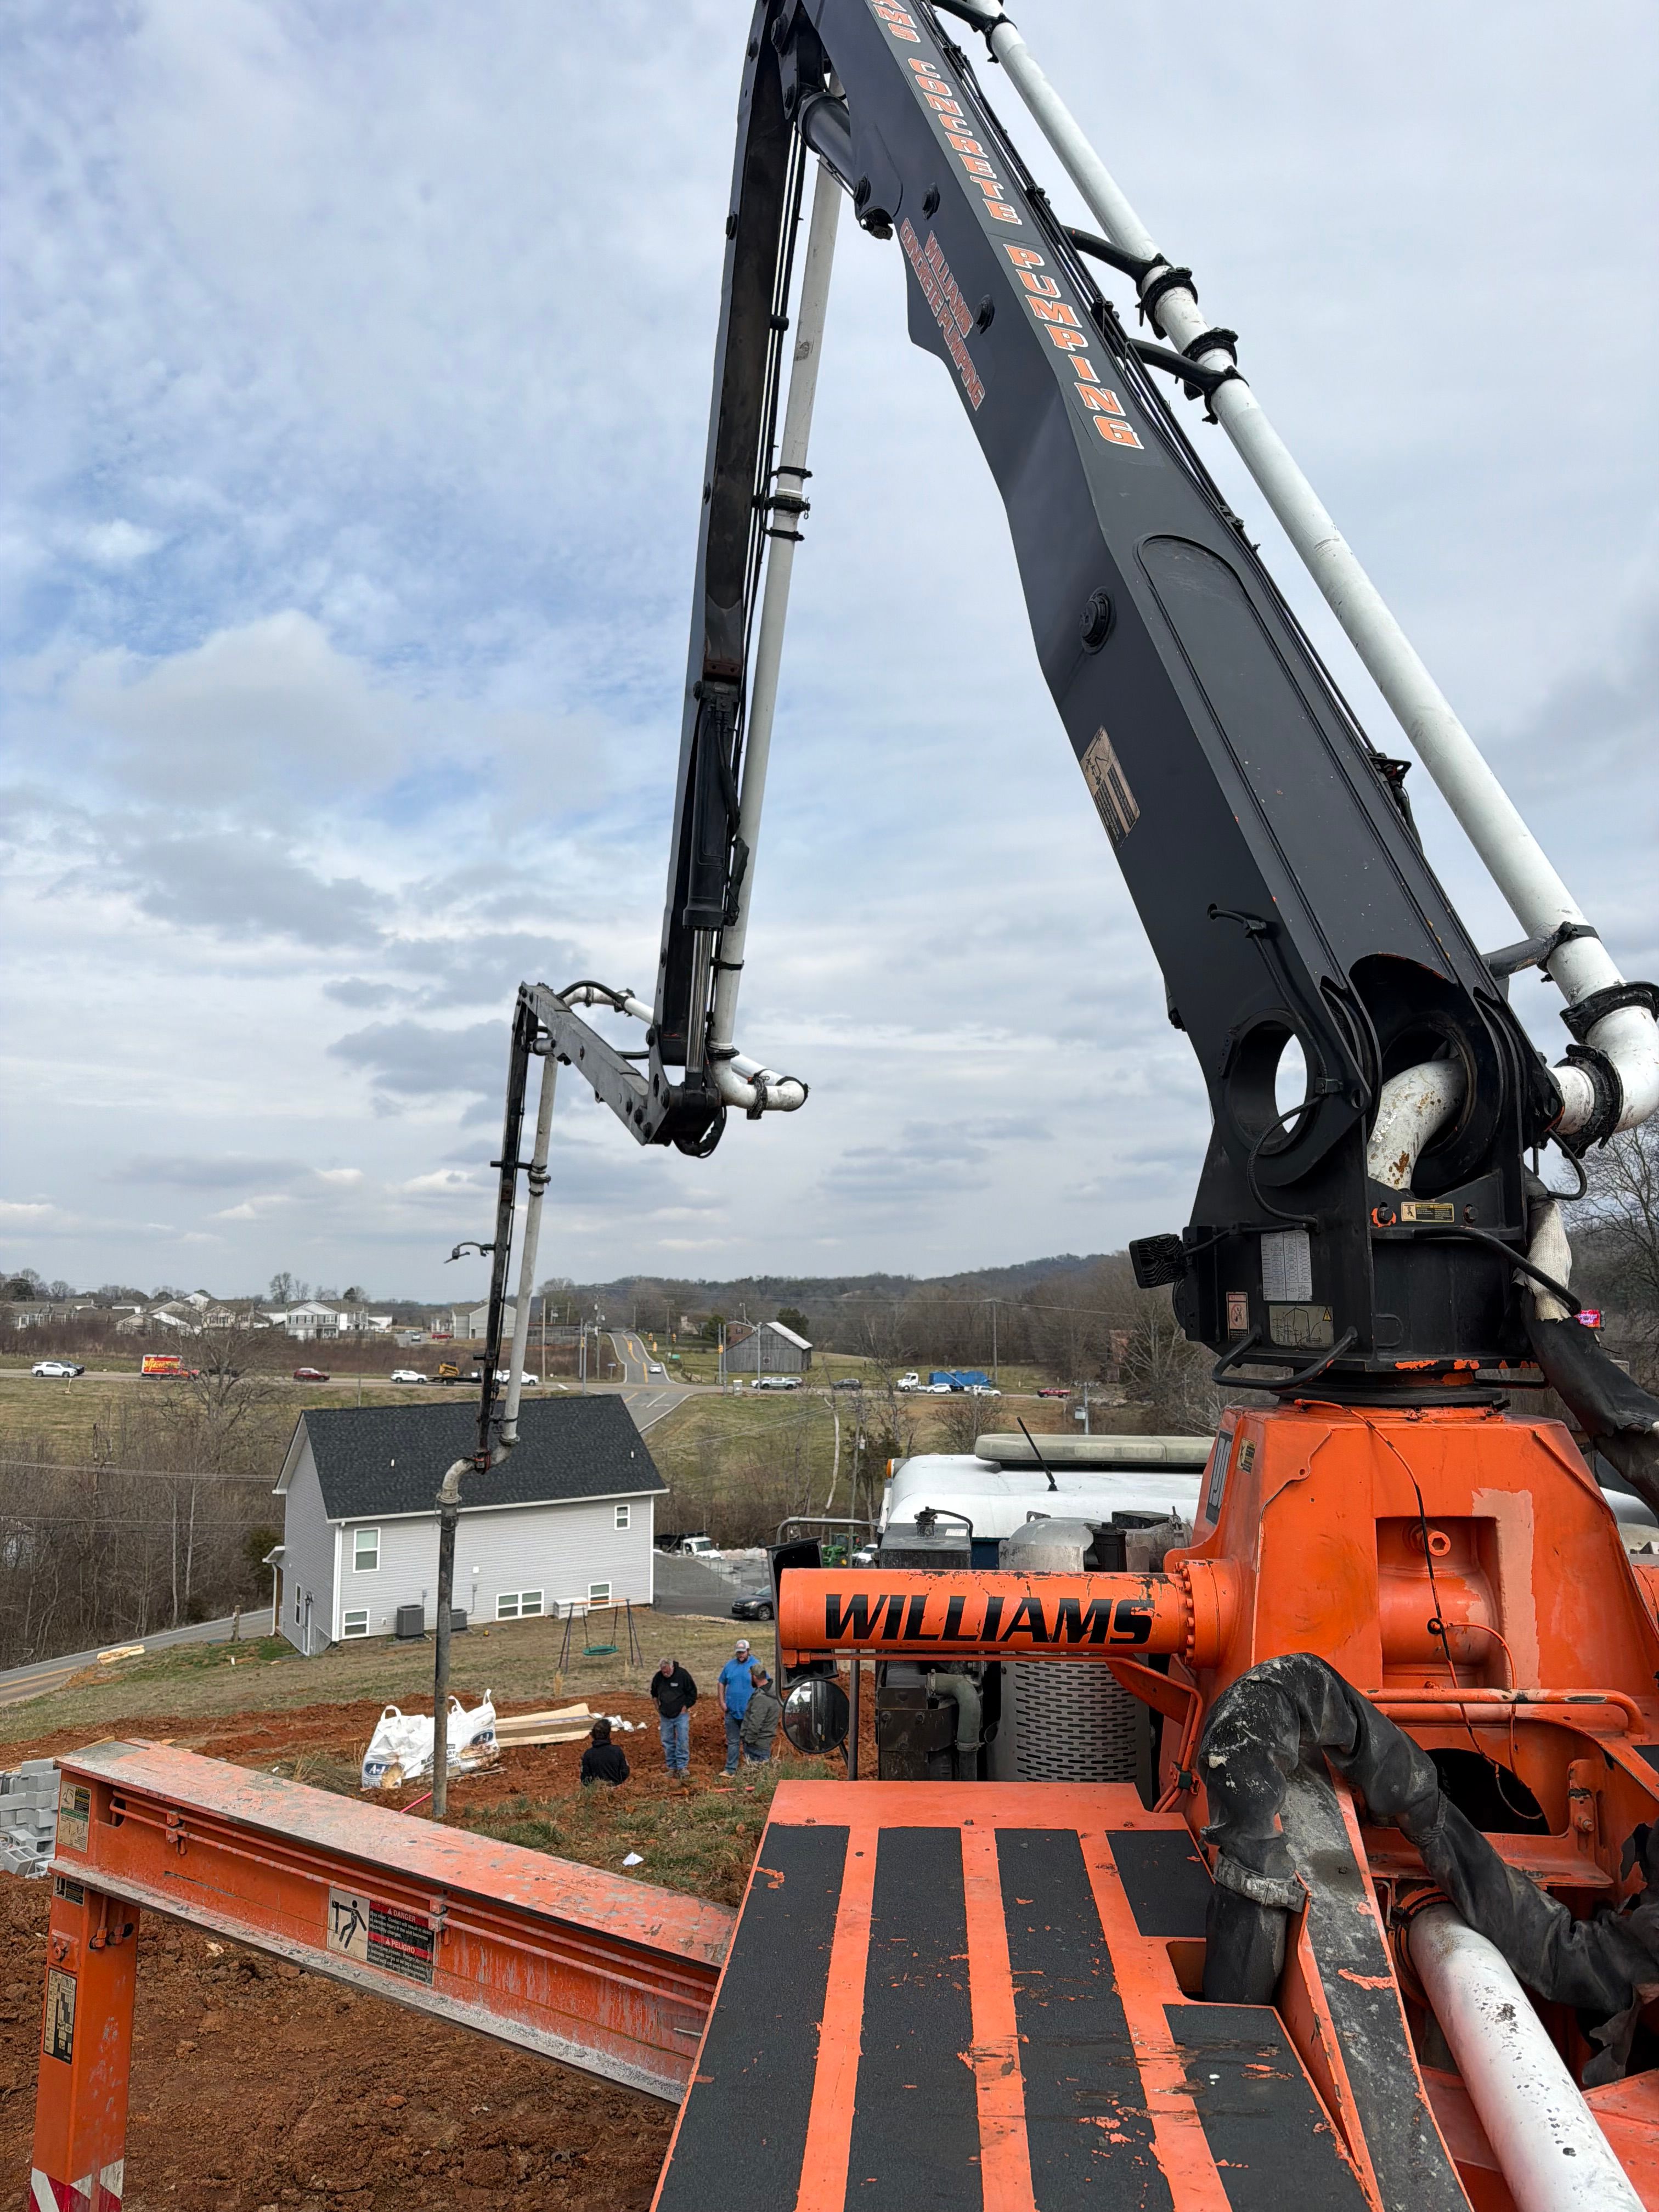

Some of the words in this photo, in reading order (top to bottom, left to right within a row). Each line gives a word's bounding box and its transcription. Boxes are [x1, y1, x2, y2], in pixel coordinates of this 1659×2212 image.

[908, 58, 1023, 225] CONCRETE
[1003, 244, 1144, 449] PUMPING
[925, 230, 973, 338] WILLIAMS
[900, 218, 944, 317] CONCRETE
[938, 303, 985, 411] PUMPING
[825, 1594, 1155, 1644] WILLIAMS
[391, 1939, 415, 1954] PELIGRO
[393, 1909, 415, 1923] DANGER
